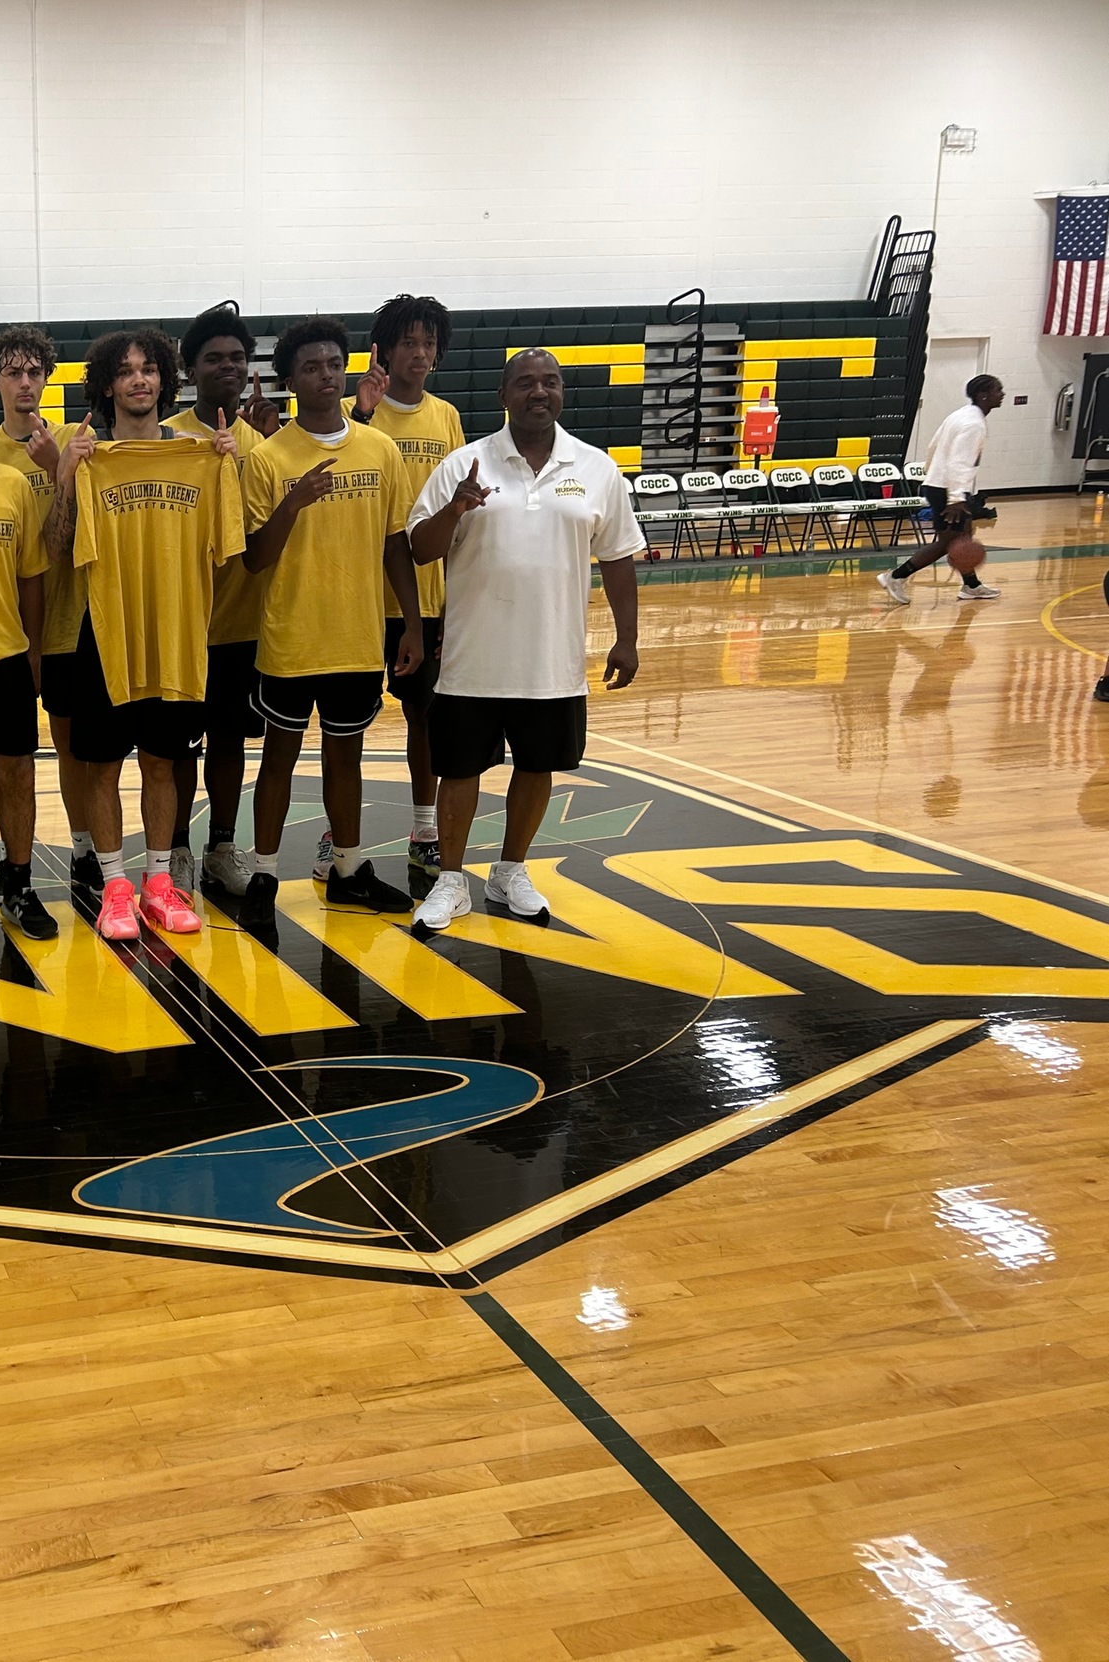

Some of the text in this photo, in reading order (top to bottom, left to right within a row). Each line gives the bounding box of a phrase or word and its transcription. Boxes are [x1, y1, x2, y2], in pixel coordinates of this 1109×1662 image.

[396, 441, 445, 456] UMBIA GREENE
[403, 457, 441, 465] ETBAL
[776, 471, 803, 482] CGCC
[819, 469, 846, 481] CGCC
[865, 466, 894, 478] CGCC
[909, 466, 927, 477] CG
[351, 473, 379, 487] GREENE
[640, 478, 671, 489] CGCC
[687, 475, 715, 487] CGCC
[729, 473, 760, 485] CGCC
[123, 483, 163, 501] COLUMBIA
[165, 485, 196, 504] GREENE
[320, 491, 376, 502] KETBALL
[851, 503, 877, 511] TWINS
[894, 498, 922, 506] TWINS
[716, 509, 743, 517] TWINS
[750, 505, 780, 514] TWINS
[810, 504, 835, 512] TWINS
[634, 513, 653, 521] WINS
[665, 511, 694, 519] TWINS
